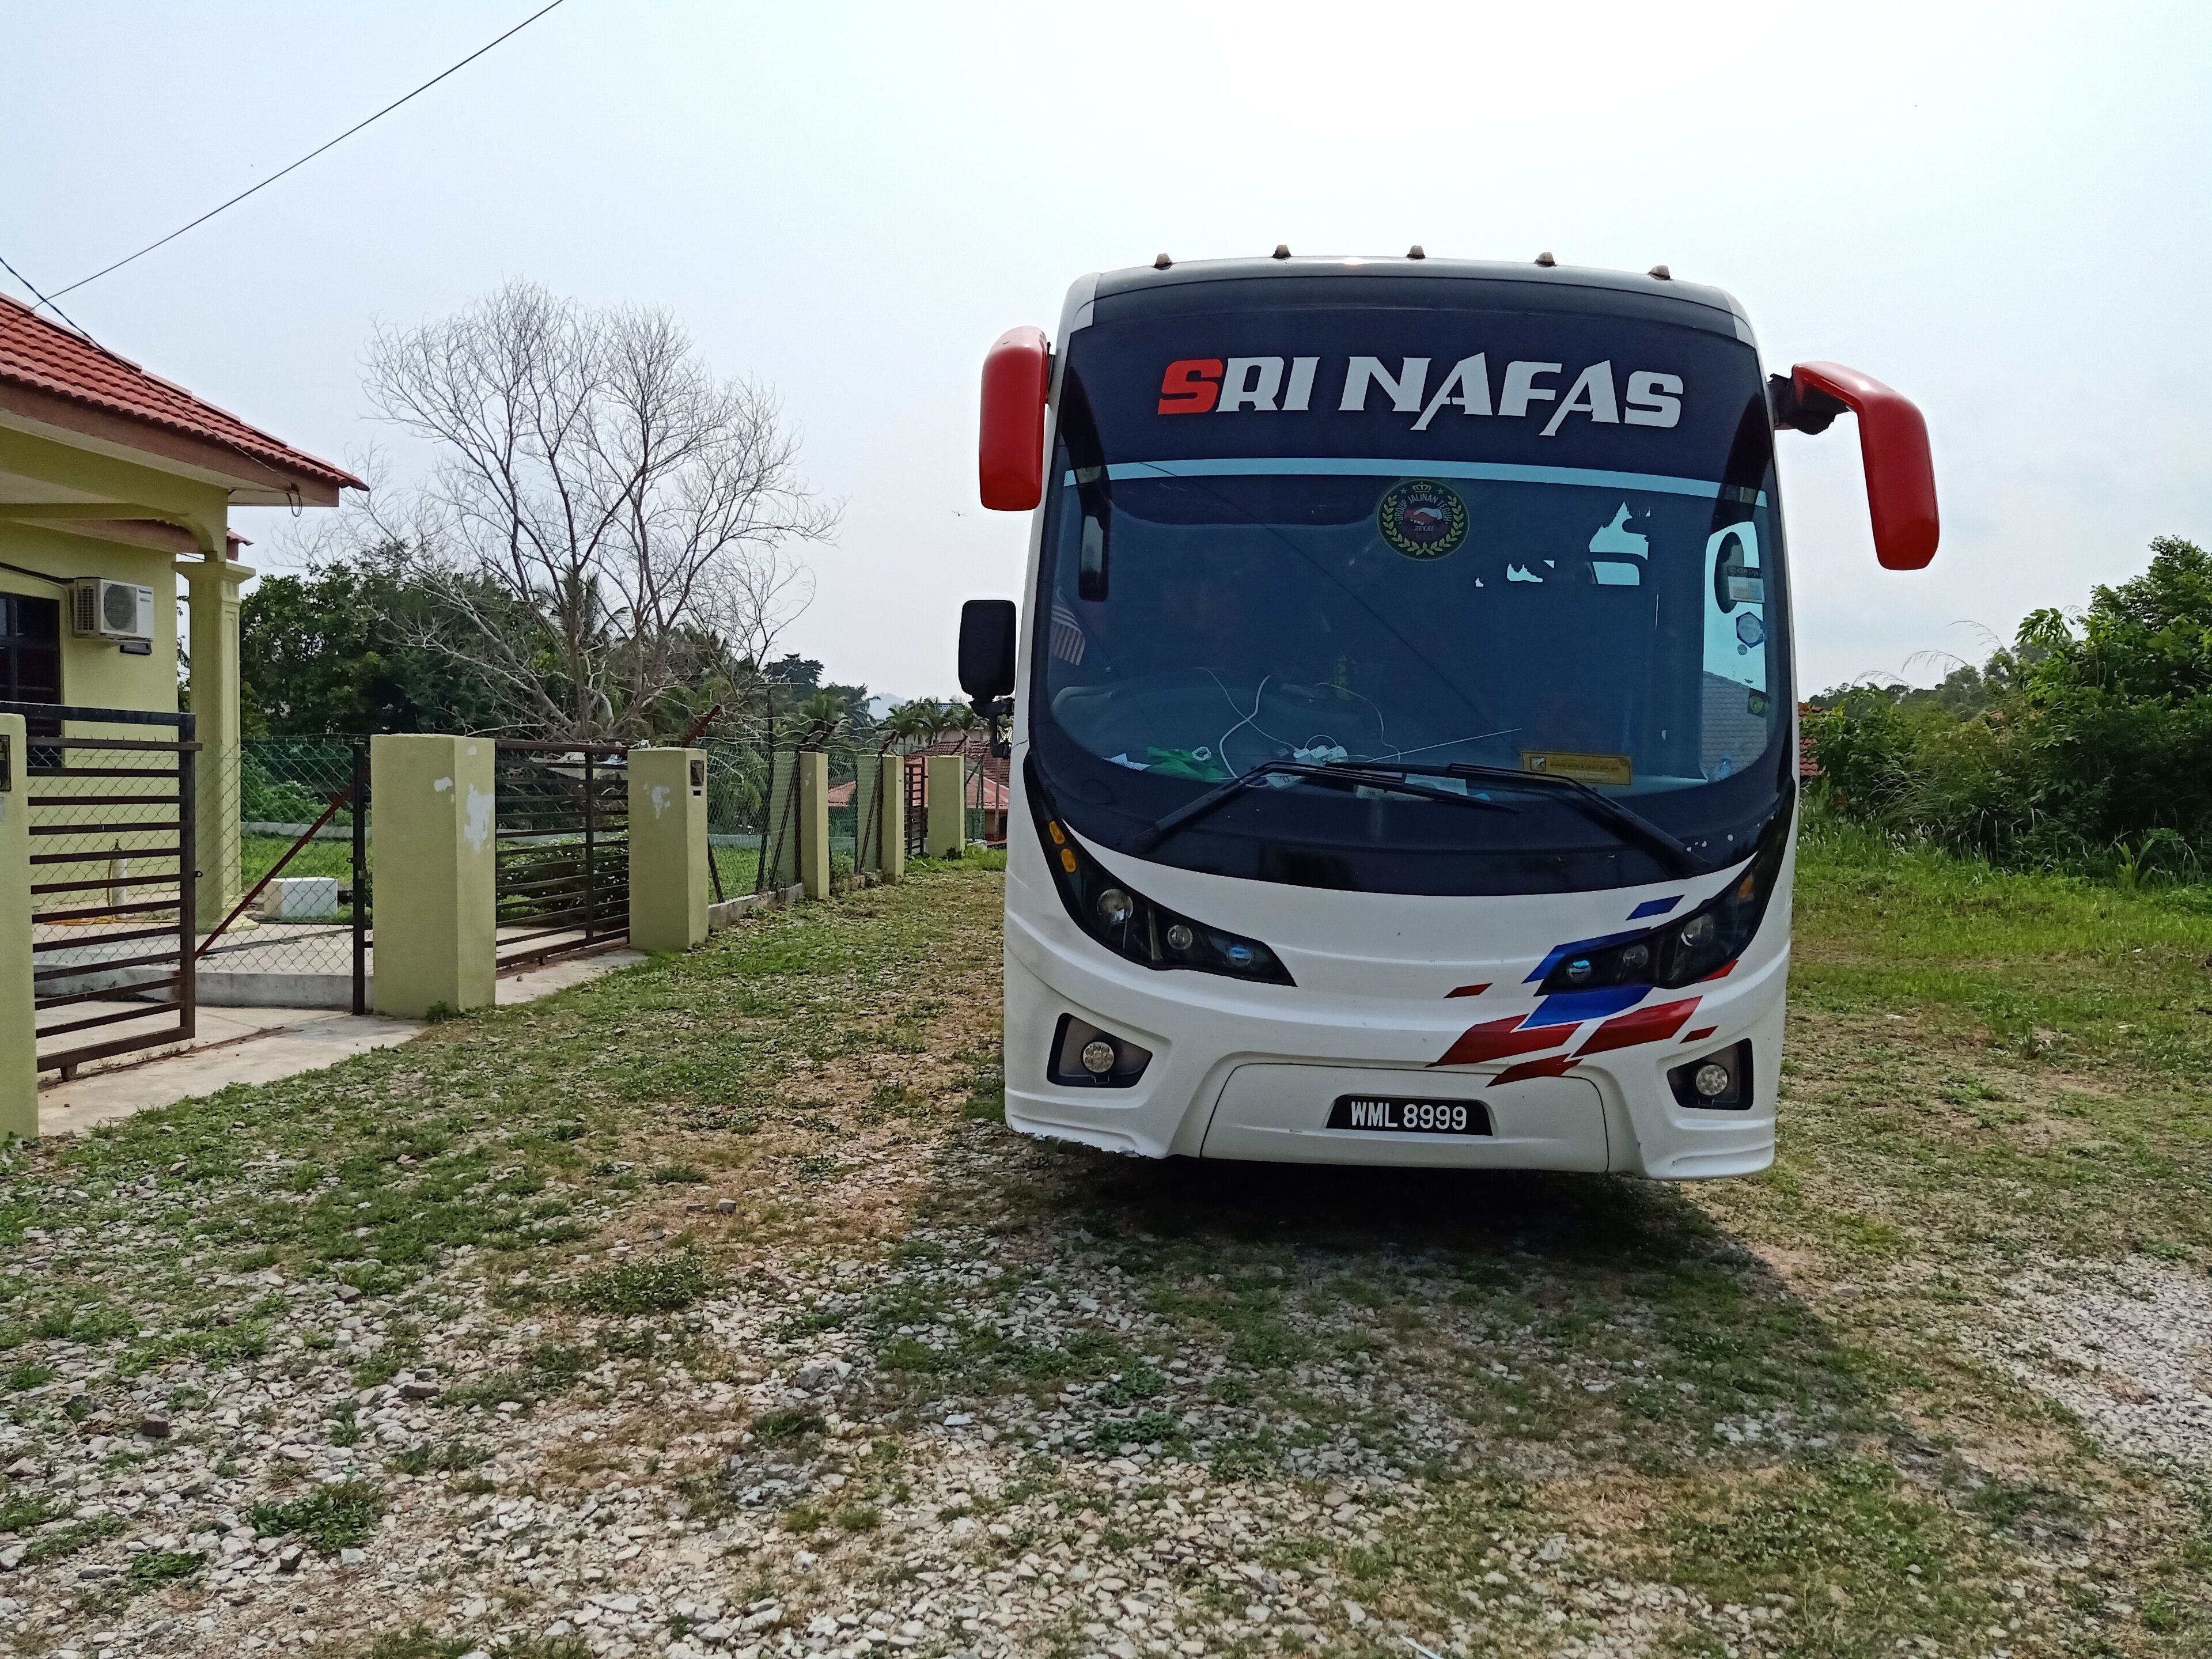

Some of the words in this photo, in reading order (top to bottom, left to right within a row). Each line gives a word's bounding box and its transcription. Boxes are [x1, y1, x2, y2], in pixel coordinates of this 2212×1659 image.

[1157, 356, 1321, 415] SRI
[1338, 352, 1684, 435] NAFAS
[1395, 499, 1408, 521] GROUP
[1407, 493, 1438, 504] JALINAN
[1437, 499, 1452, 521] TEGUH
[1351, 1101, 1398, 1127] WML
[1403, 1104, 1467, 1130] 8999
